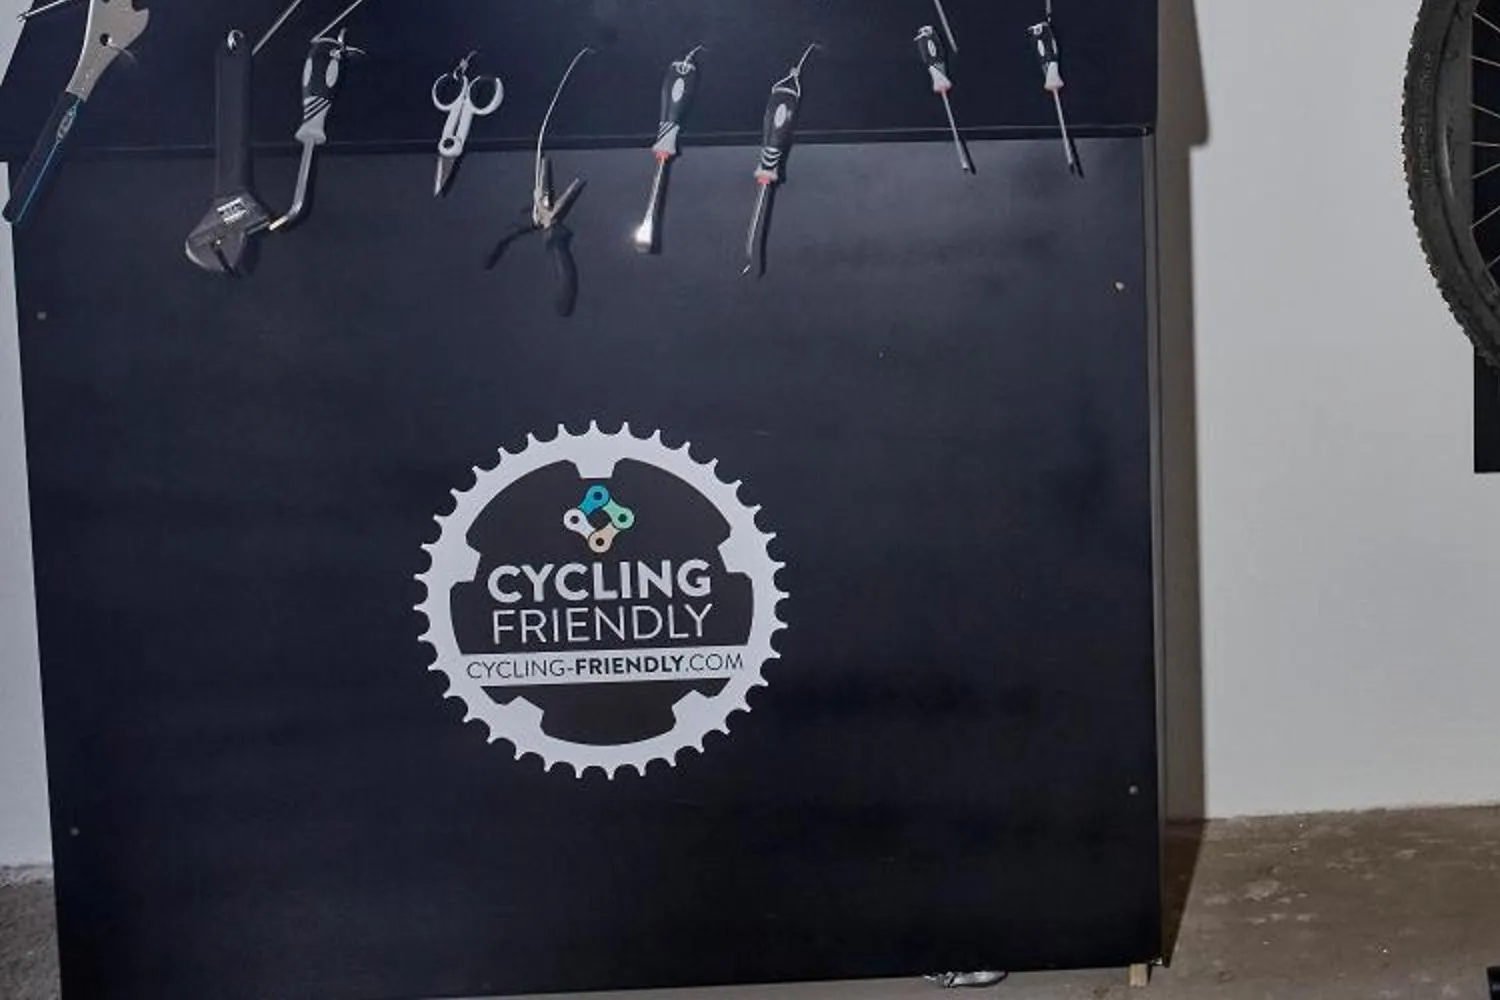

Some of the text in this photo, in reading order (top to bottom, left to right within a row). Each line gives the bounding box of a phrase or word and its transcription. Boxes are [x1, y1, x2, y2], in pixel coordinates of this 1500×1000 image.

[487, 559, 712, 604] CYCLING
[492, 603, 713, 646] FRIENDLY
[466, 652, 745, 681] CYCLING-FRIENDLY.COM
